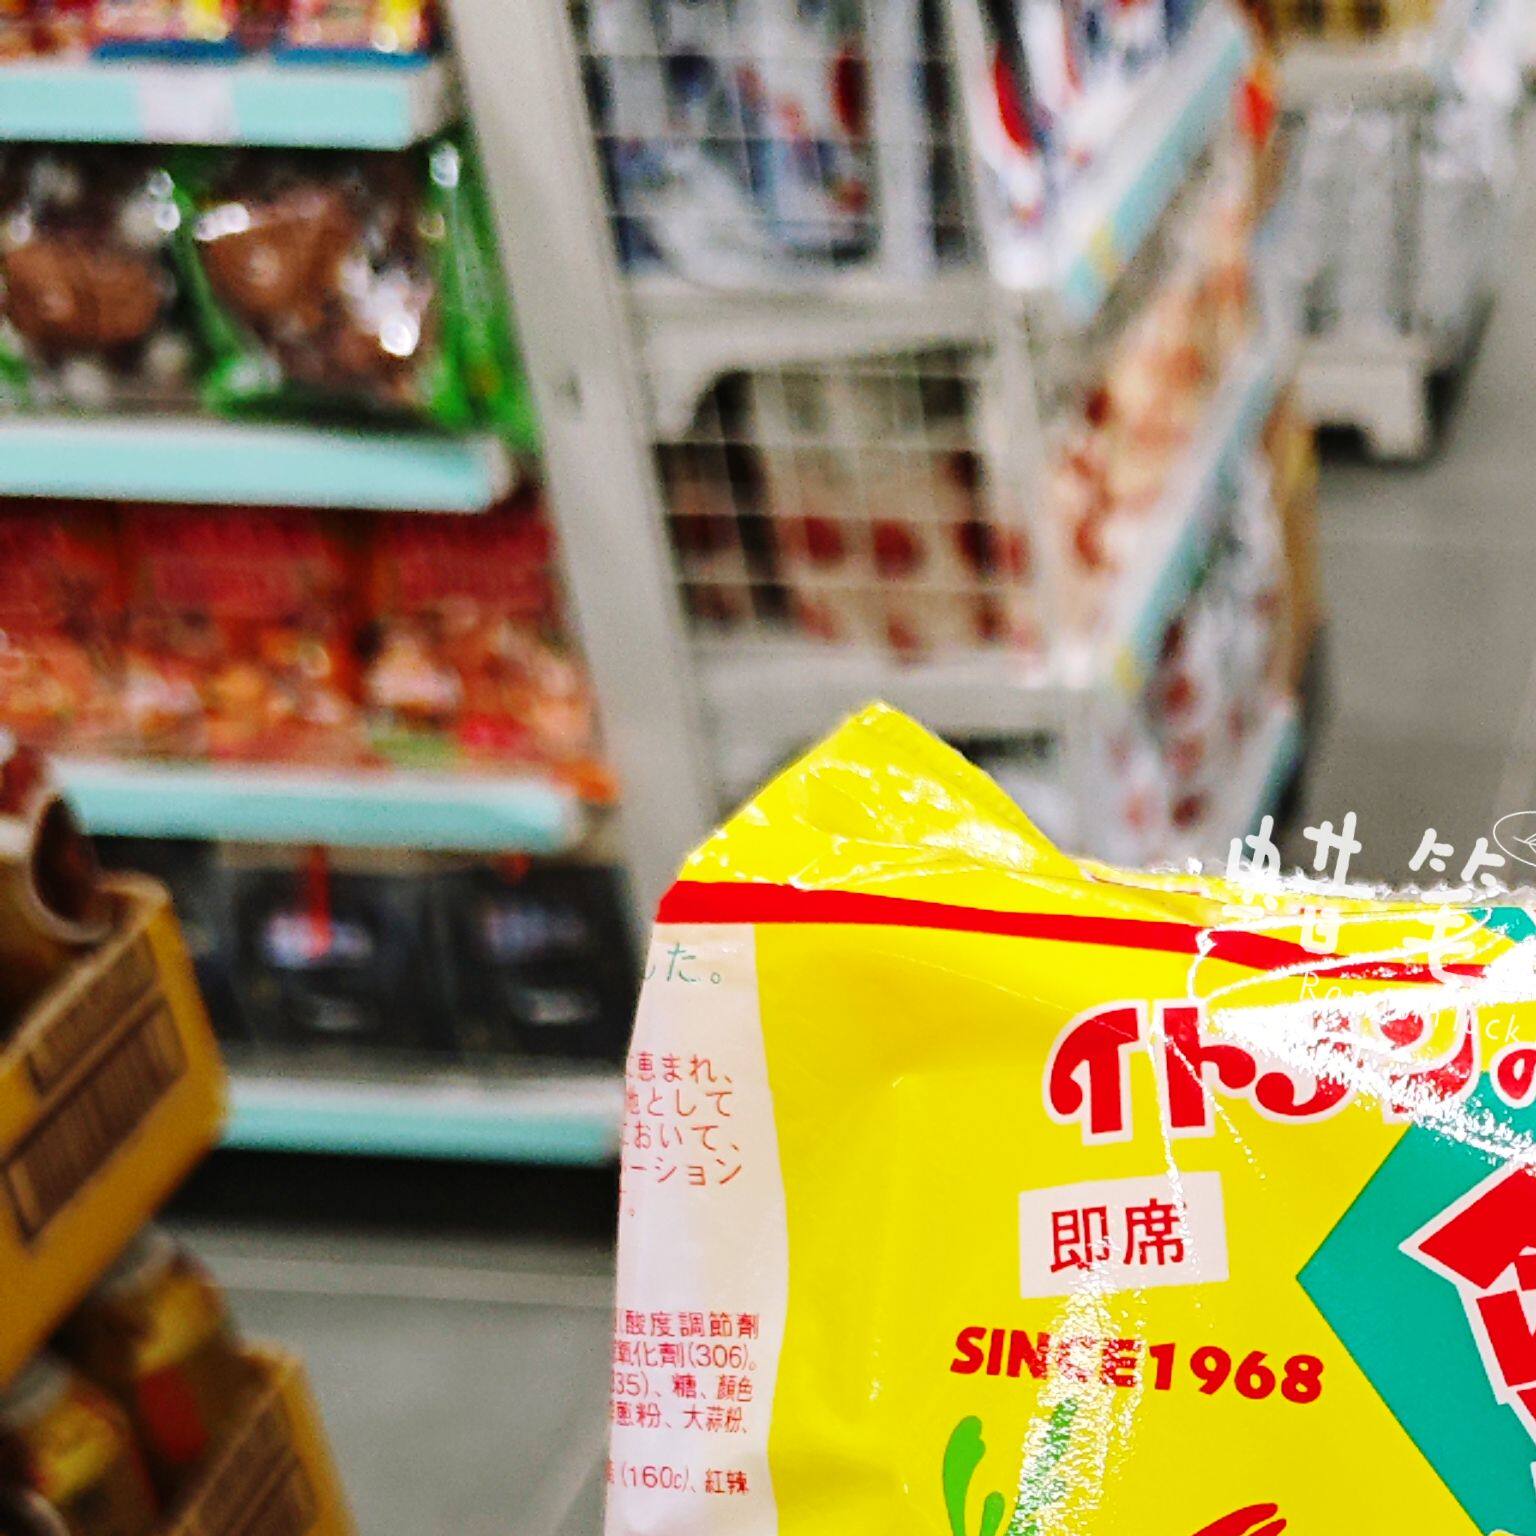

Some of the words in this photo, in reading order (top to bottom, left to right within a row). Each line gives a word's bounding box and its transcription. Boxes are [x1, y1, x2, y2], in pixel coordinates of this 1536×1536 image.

[619, 1157, 743, 1187] ーション
[1050, 1197, 1188, 1274] 即席
